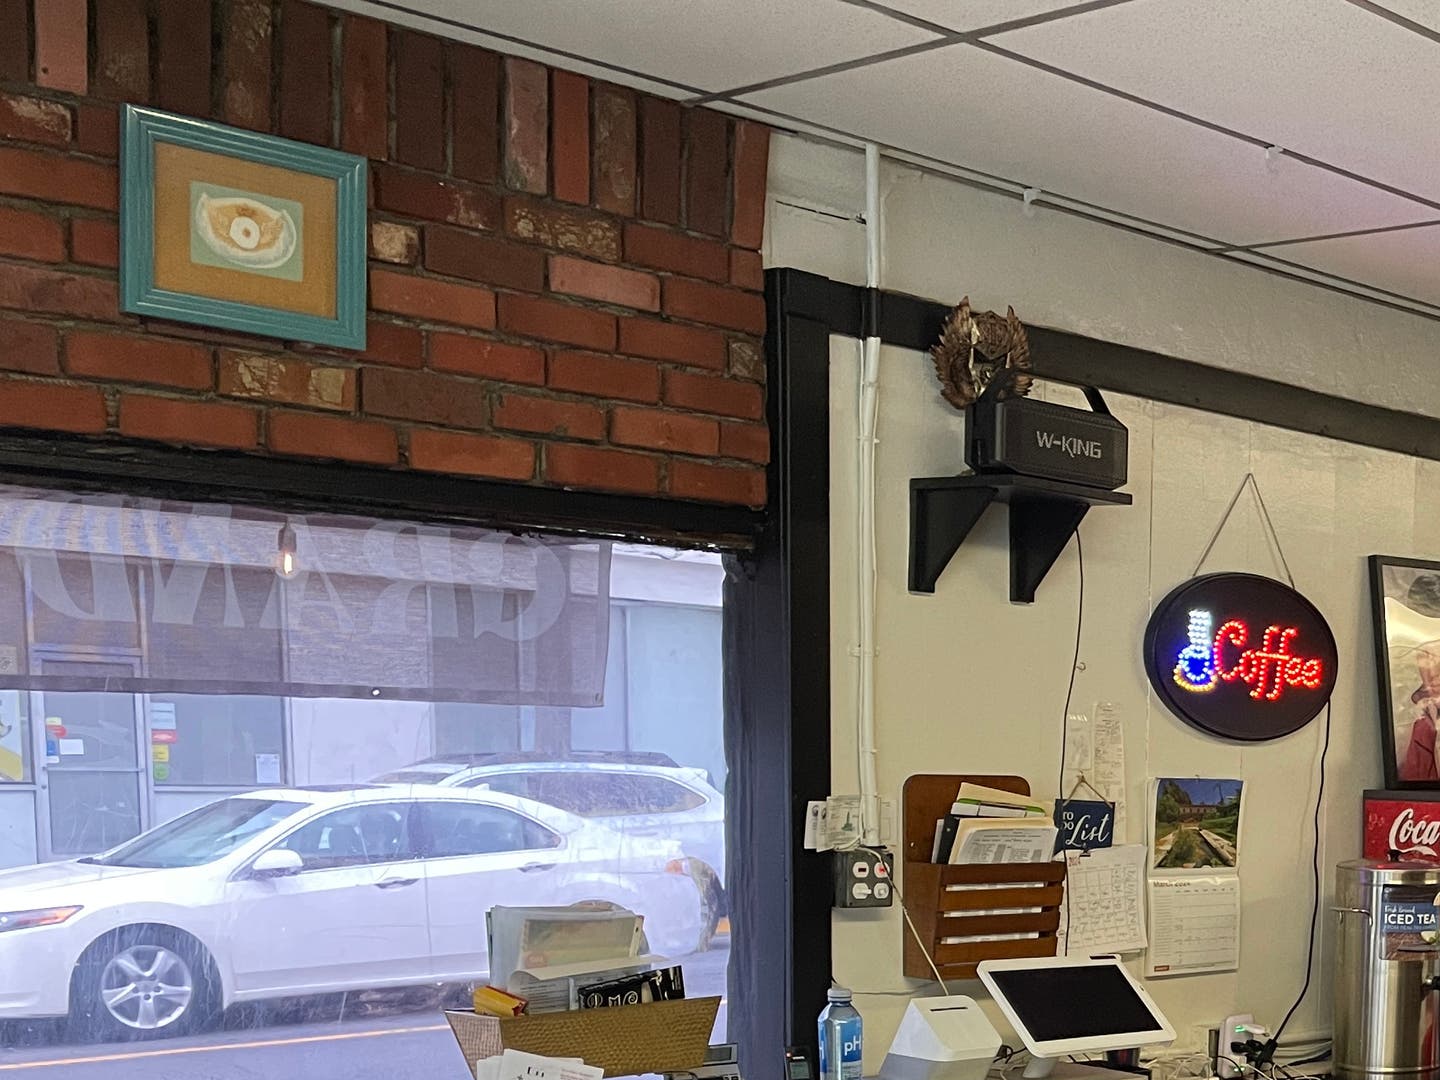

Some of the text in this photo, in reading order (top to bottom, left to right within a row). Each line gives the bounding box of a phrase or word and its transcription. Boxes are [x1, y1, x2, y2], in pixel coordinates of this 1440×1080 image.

[1036, 430, 1102, 459] W-KING
[1213, 619, 1322, 701] Coffee
[1065, 813, 1110, 848] List
[1384, 913, 1437, 925] ICED TEA
